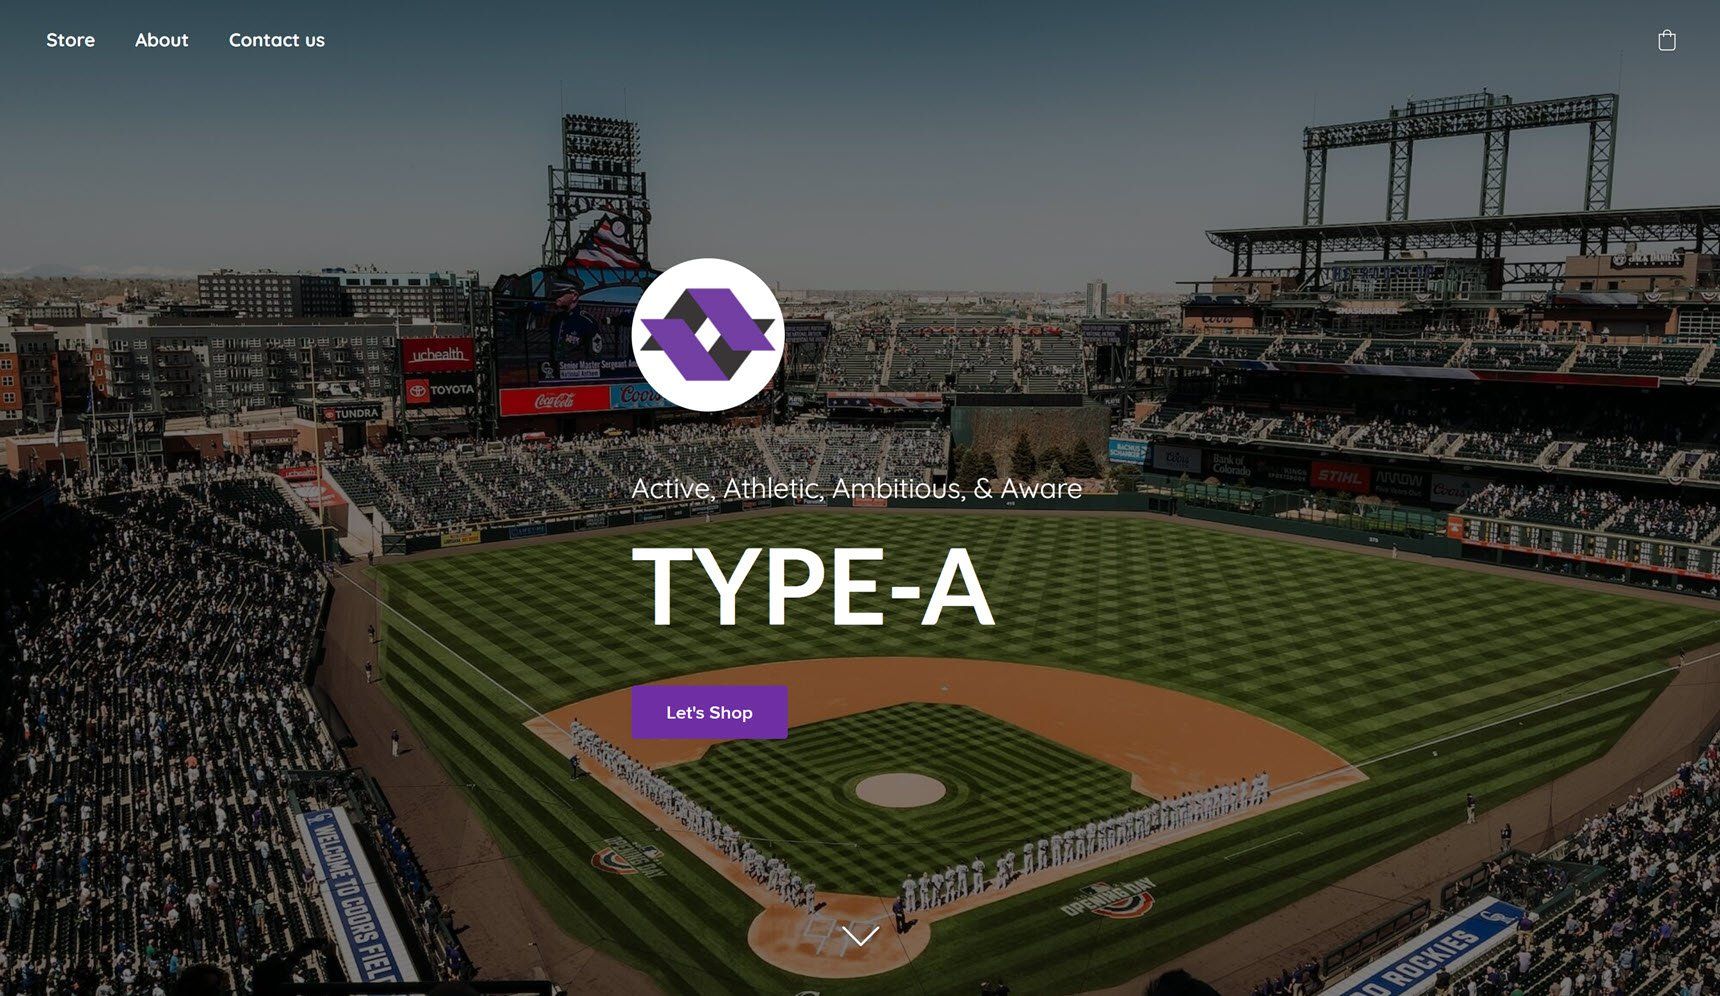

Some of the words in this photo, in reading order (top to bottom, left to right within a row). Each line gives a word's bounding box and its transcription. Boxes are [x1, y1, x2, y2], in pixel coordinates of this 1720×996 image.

[1202, 312, 1235, 324] Coors
[412, 347, 464, 361] uchealth
[560, 361, 579, 370] Senior
[580, 360, 600, 370] Master
[601, 360, 627, 371] Sergeant
[430, 384, 475, 395] TOYOTA
[535, 392, 576, 409] Coca-Cola
[335, 408, 379, 419] TUNDRA
[1212, 453, 1234, 465] Bank
[1235, 455, 1245, 465] of
[1212, 463, 1252, 477] Colorado
[1317, 469, 1363, 485] STIHL
[1433, 482, 1465, 498] Coors
[314, 824, 354, 880] WELCOME
[334, 879, 361, 897] TO
[1060, 887, 1131, 917] OPENING
[1123, 877, 1157, 894] DAY
[341, 897, 380, 944] COORS
[1381, 929, 1480, 987] ROCKIES
